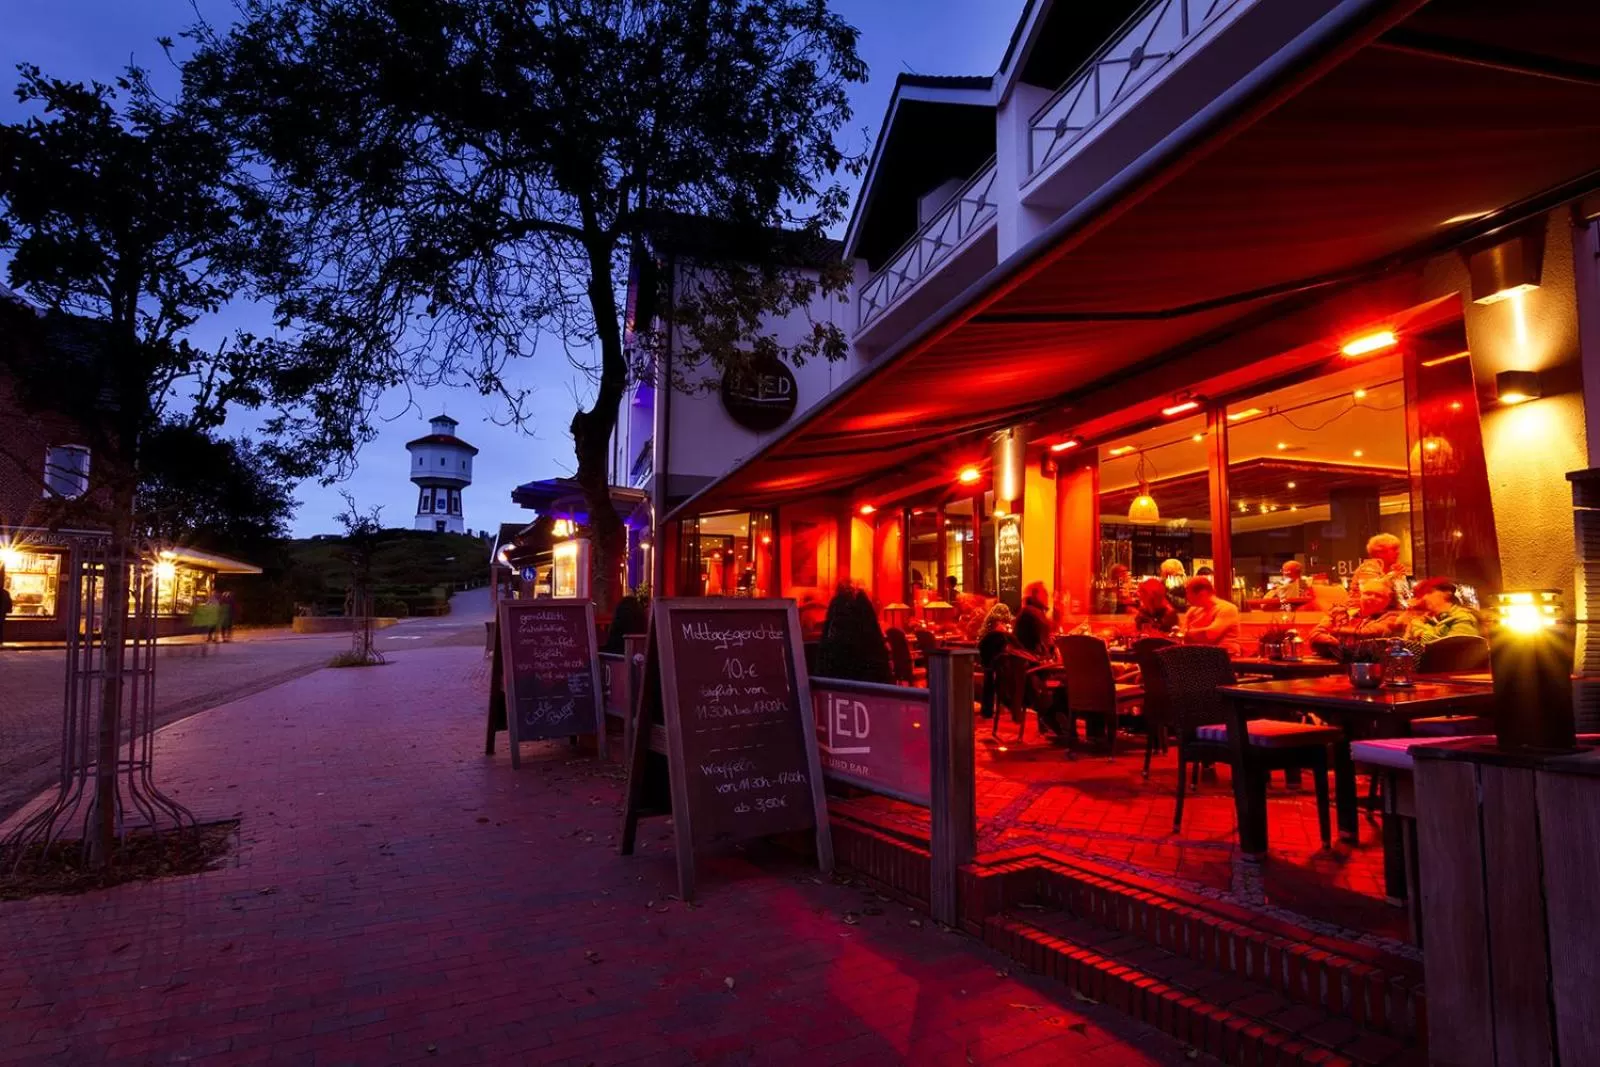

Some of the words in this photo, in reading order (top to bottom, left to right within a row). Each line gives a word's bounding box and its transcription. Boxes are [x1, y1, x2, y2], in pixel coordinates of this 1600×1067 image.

[744, 686, 769, 696] von
[716, 781, 739, 793] von
[734, 801, 751, 813] ab
